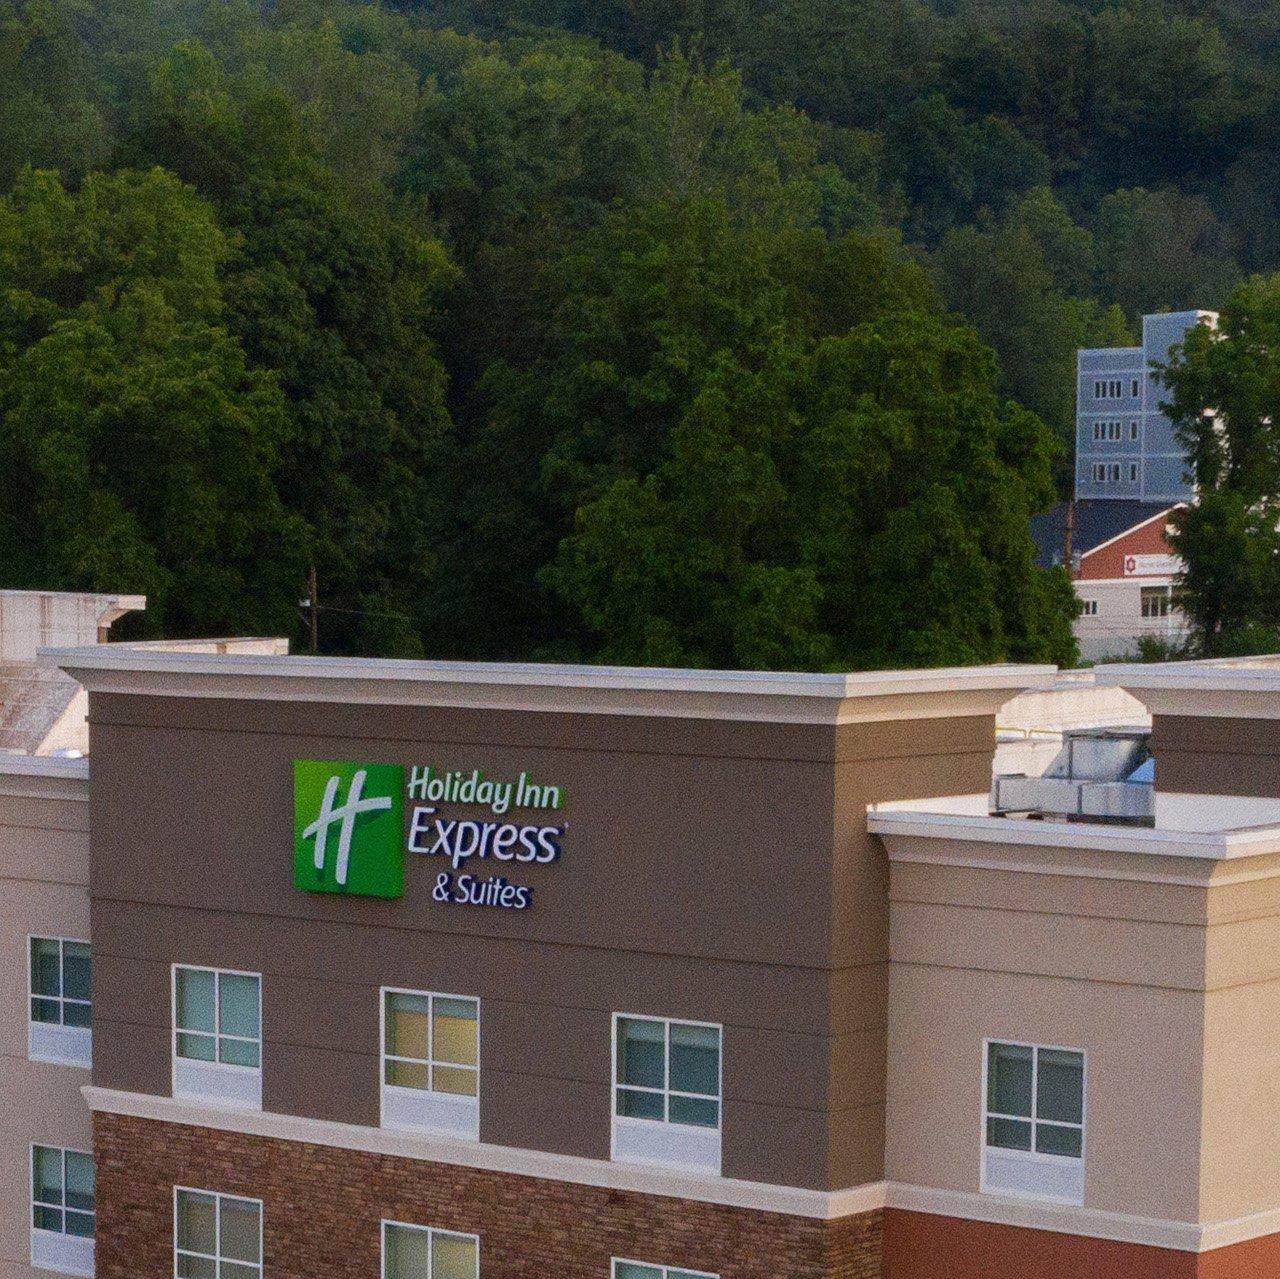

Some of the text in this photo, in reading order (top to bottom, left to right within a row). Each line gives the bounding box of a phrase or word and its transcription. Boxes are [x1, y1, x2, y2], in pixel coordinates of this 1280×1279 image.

[408, 766, 560, 814] Holiday Inn
[408, 806, 560, 870] Express
[432, 873, 528, 909] & Suites
